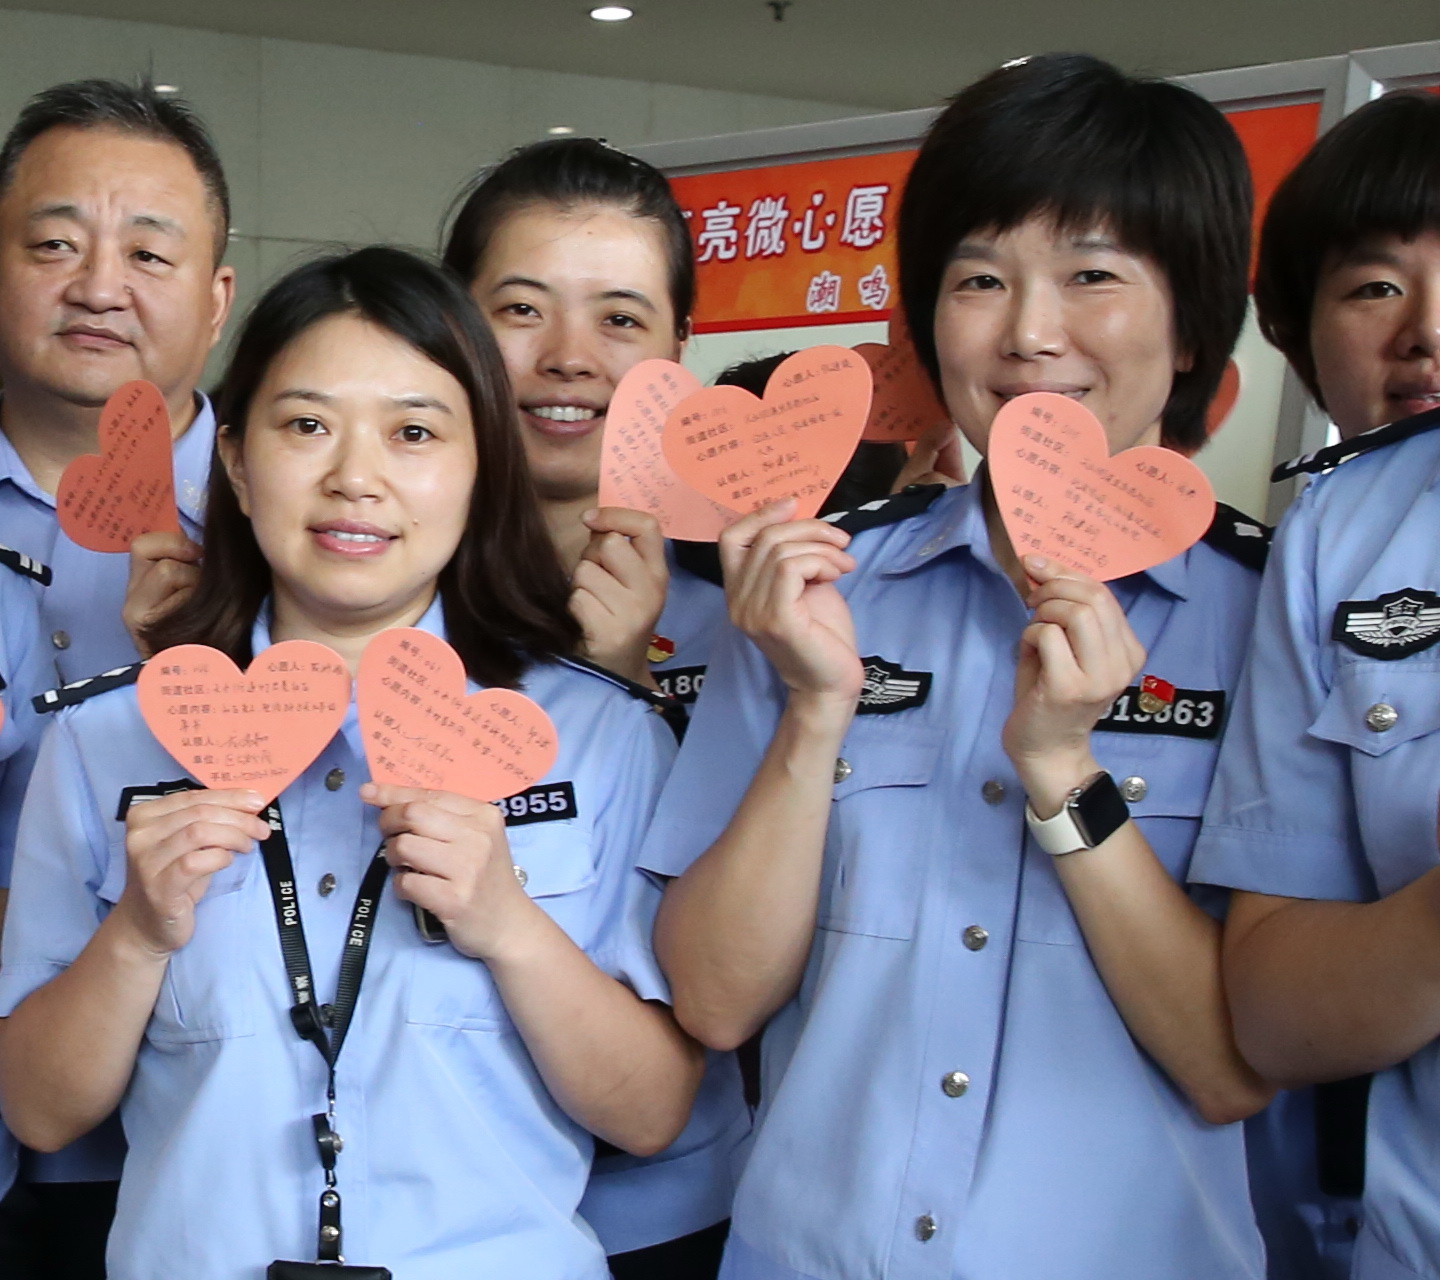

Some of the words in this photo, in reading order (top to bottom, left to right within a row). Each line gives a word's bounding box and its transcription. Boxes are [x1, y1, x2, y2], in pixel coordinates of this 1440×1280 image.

[683, 185, 889, 262] 亮微心愿
[279, 880, 299, 926] POLICE
[348, 897, 373, 947] POLICE
